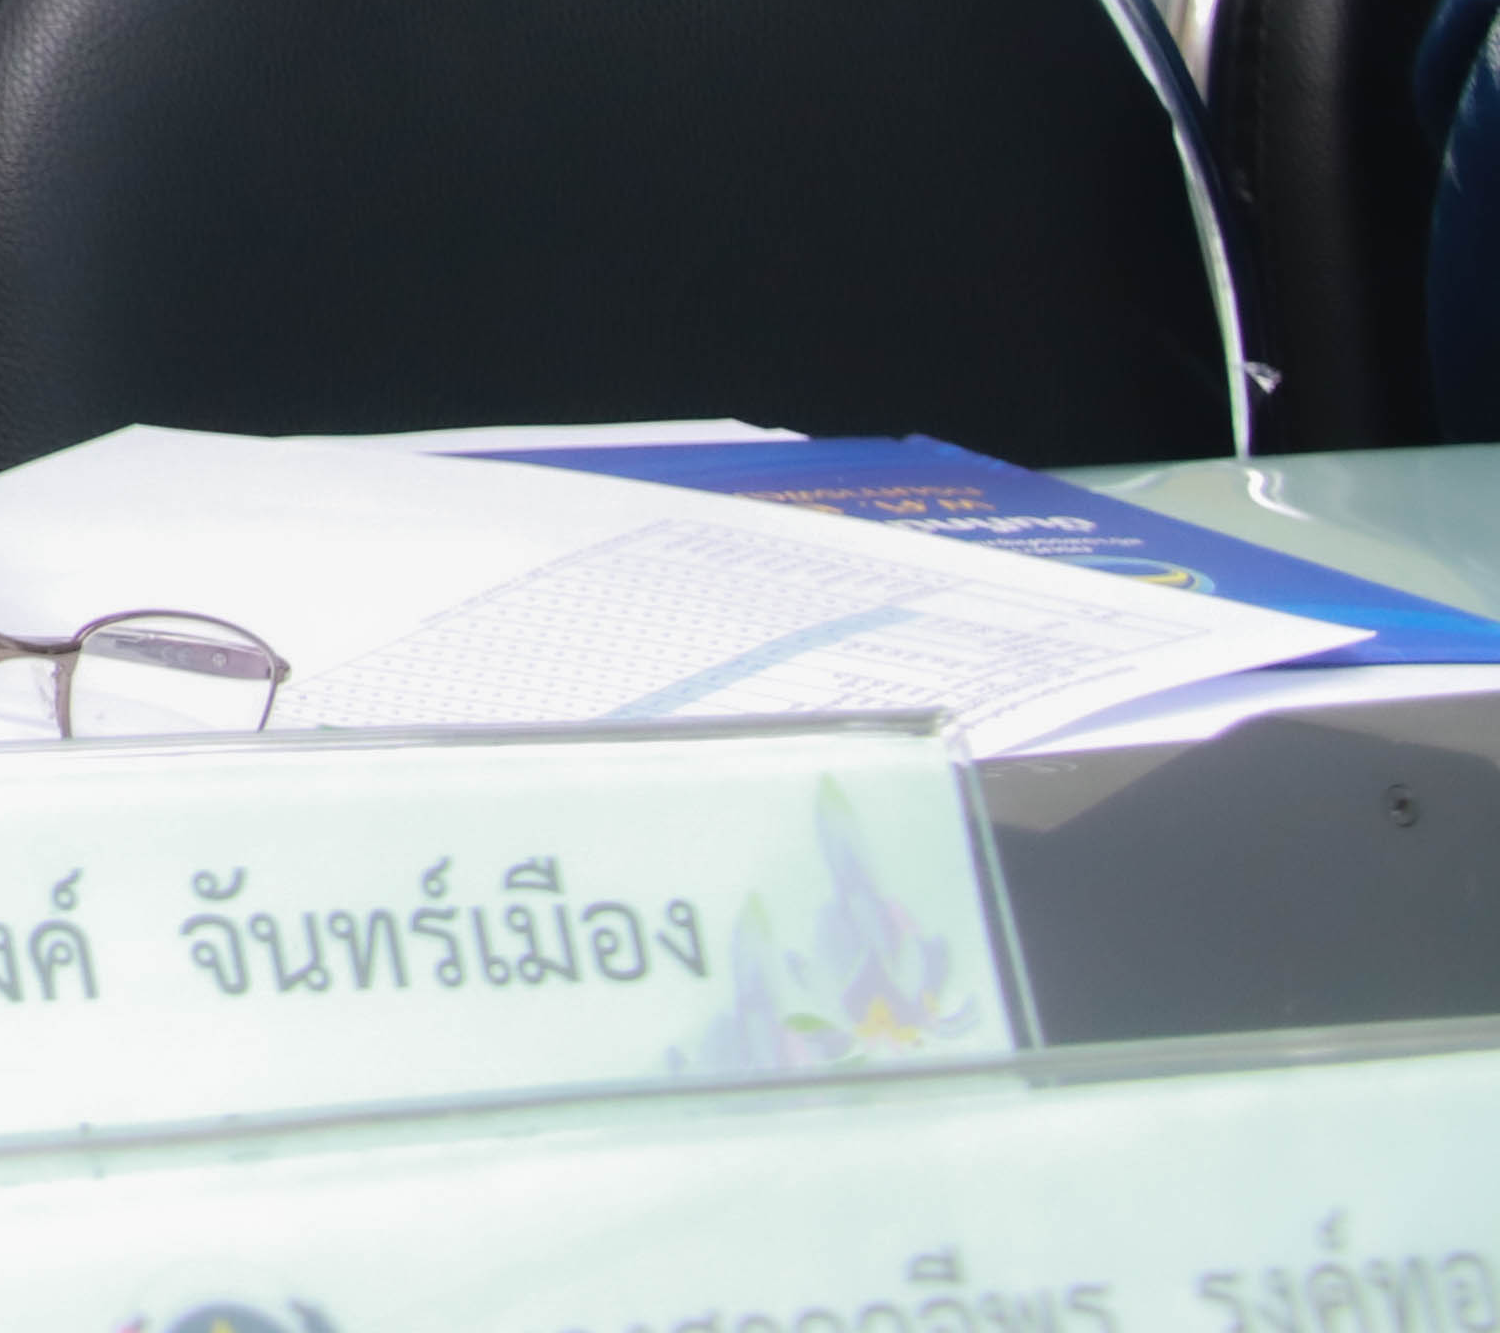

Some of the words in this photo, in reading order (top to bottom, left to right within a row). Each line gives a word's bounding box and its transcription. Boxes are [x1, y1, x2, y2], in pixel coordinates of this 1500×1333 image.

[179, 856, 711, 1000] จันทร์เมือง
